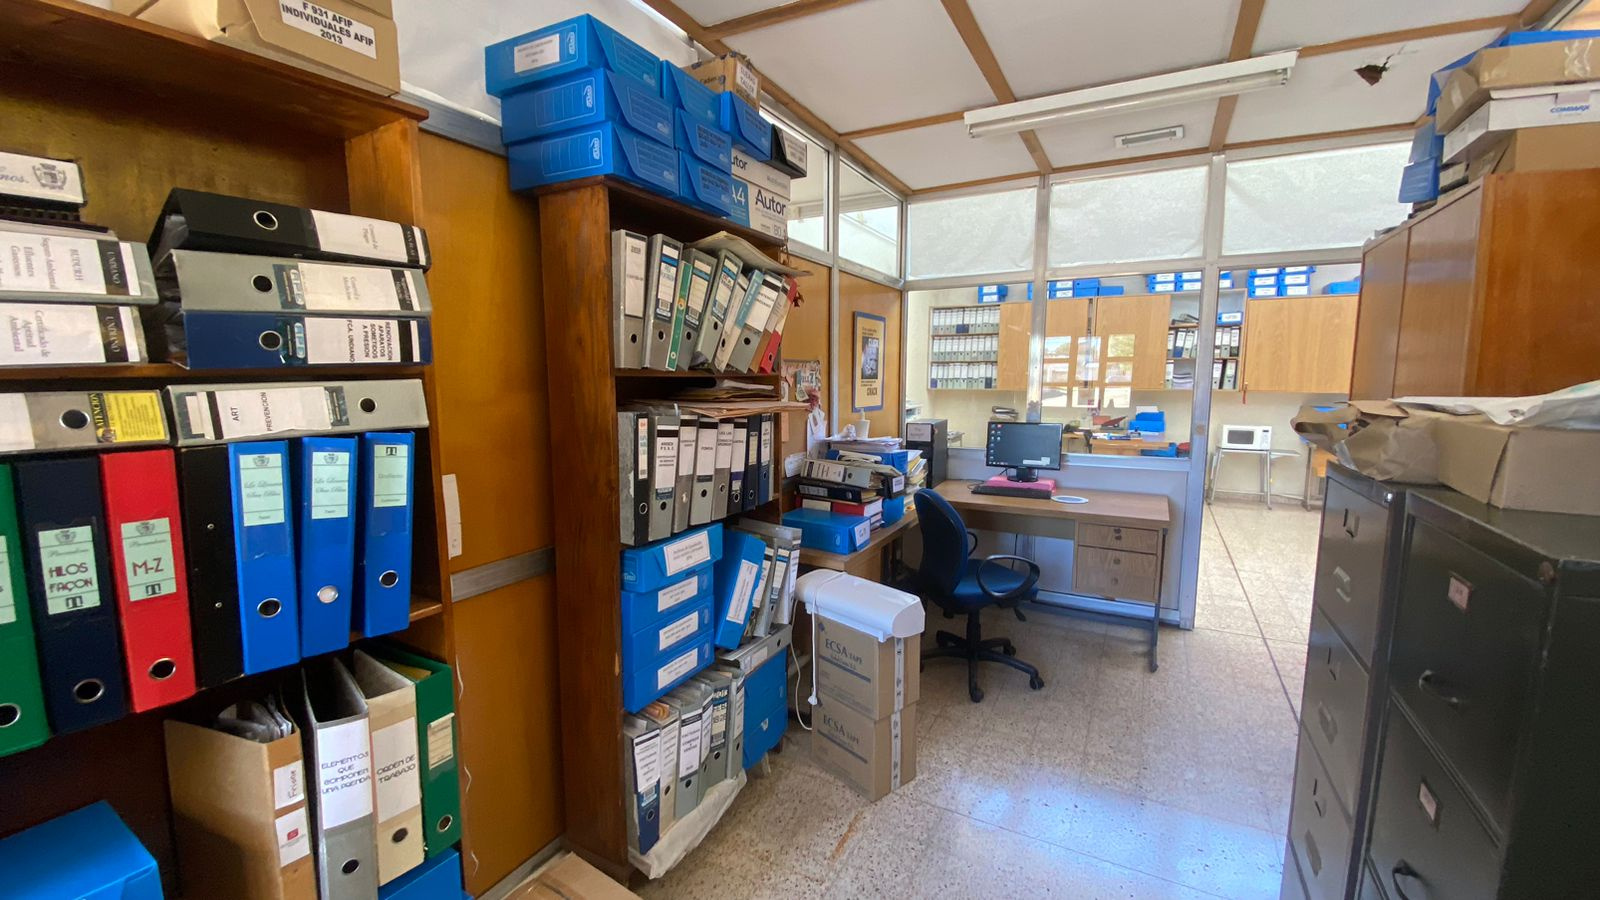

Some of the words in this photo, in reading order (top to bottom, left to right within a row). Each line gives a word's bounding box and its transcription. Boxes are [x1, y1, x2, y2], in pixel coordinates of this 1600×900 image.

[303, 2, 309, 11] F
[311, 4, 329, 20] 931
[332, 14, 353, 28] AFIP
[282, 4, 351, 38] INDIVIDUALES
[354, 33, 374, 47] AFIP
[320, 29, 343, 45] 2013
[755, 189, 787, 217] Autor
[9, 315, 24, 352] Ambiental
[35, 310, 49, 348] Certificado
[347, 334, 356, 363] UNDIANO
[370, 323, 378, 359] SOMETIDOS
[378, 324, 386, 357] APARATOS
[385, 321, 393, 361] RENOVACION
[41, 350, 50, 358] de
[231, 407, 240, 421] ART
[261, 391, 273, 431] PREVENCION
[48, 562, 89, 578] HILOS
[132, 557, 164, 577] M-Z
[49, 577, 93, 593] FAÇON
[825, 638, 848, 657] ECSA
[824, 714, 845, 737] ECSA
[321, 751, 369, 770] ELEMENTOS
[338, 763, 355, 774] QUE
[376, 759, 405, 775] ORDEN
[406, 754, 416, 764] DE
[324, 768, 369, 786] COMPONEN
[377, 764, 417, 784] TRABAJO
[322, 785, 339, 795] UNA
